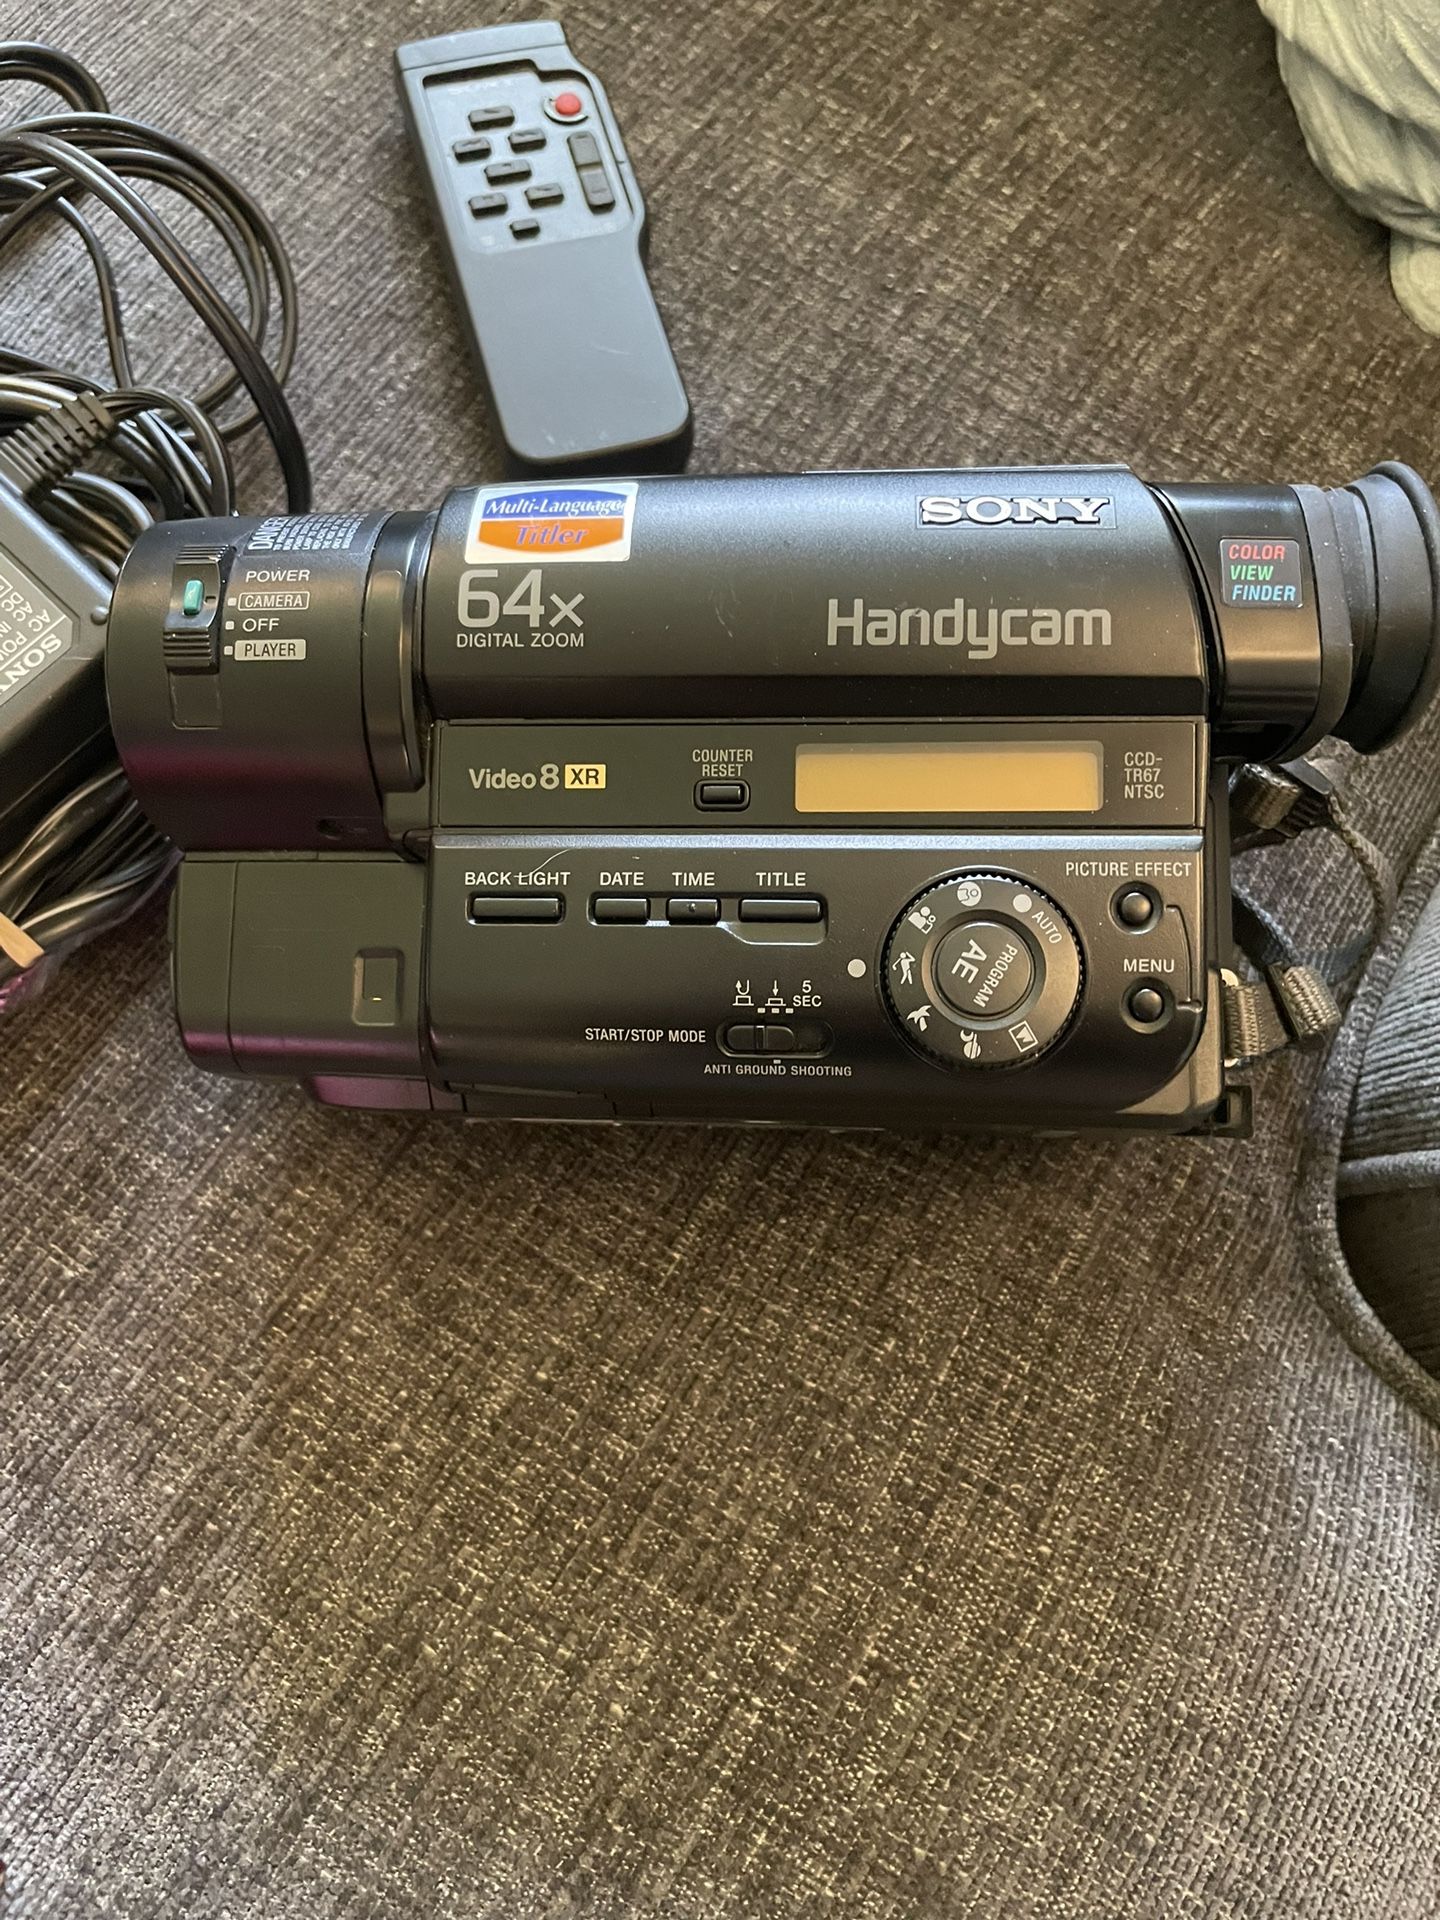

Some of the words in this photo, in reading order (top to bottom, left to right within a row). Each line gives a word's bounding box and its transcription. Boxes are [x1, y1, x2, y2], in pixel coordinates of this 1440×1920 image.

[920, 496, 1110, 525] SONY
[516, 525, 588, 545] Titler
[1228, 544, 1286, 561] COLOR
[245, 569, 311, 583] POWER
[1230, 564, 1274, 581] VIEW
[1232, 584, 1296, 601] FINDER
[1, 591, 24, 613] DC
[244, 594, 303, 608] CAMERA
[12, 601, 33, 622] AC
[28, 608, 51, 632] AC
[242, 618, 280, 632] OFF
[827, 598, 1112, 659] Handycam
[456, 633, 525, 648] DIGITAL
[530, 633, 585, 648] ZOOM
[244, 642, 297, 657] PLAYER
[692, 749, 753, 763] COUNTER
[1124, 751, 1163, 766] CCD-
[570, 768, 601, 786] XR
[702, 763, 743, 777] RESET
[1124, 768, 1161, 783] TR67
[1124, 784, 1165, 799] NTSC
[1065, 861, 1129, 876] PICTURE
[1135, 861, 1192, 877] EFFECT
[464, 871, 512, 886] BACK
[518, 871, 571, 886] LIGHT
[600, 871, 645, 886] DATE
[672, 872, 715, 887] TIME
[755, 872, 806, 887] TITLE
[1031, 910, 1063, 944] AUTO
[951, 939, 988, 984] AE
[1123, 959, 1175, 973] MENU
[973, 943, 1018, 1008] PROGRAM
[801, 980, 812, 993] 5
[792, 995, 822, 1008] SEC
[585, 1027, 664, 1043] START/STOP
[668, 1029, 706, 1043] MODE
[703, 1064, 731, 1075] ANTI
[735, 1064, 787, 1076] GROUND
[790, 1065, 852, 1077] SHOOTING
